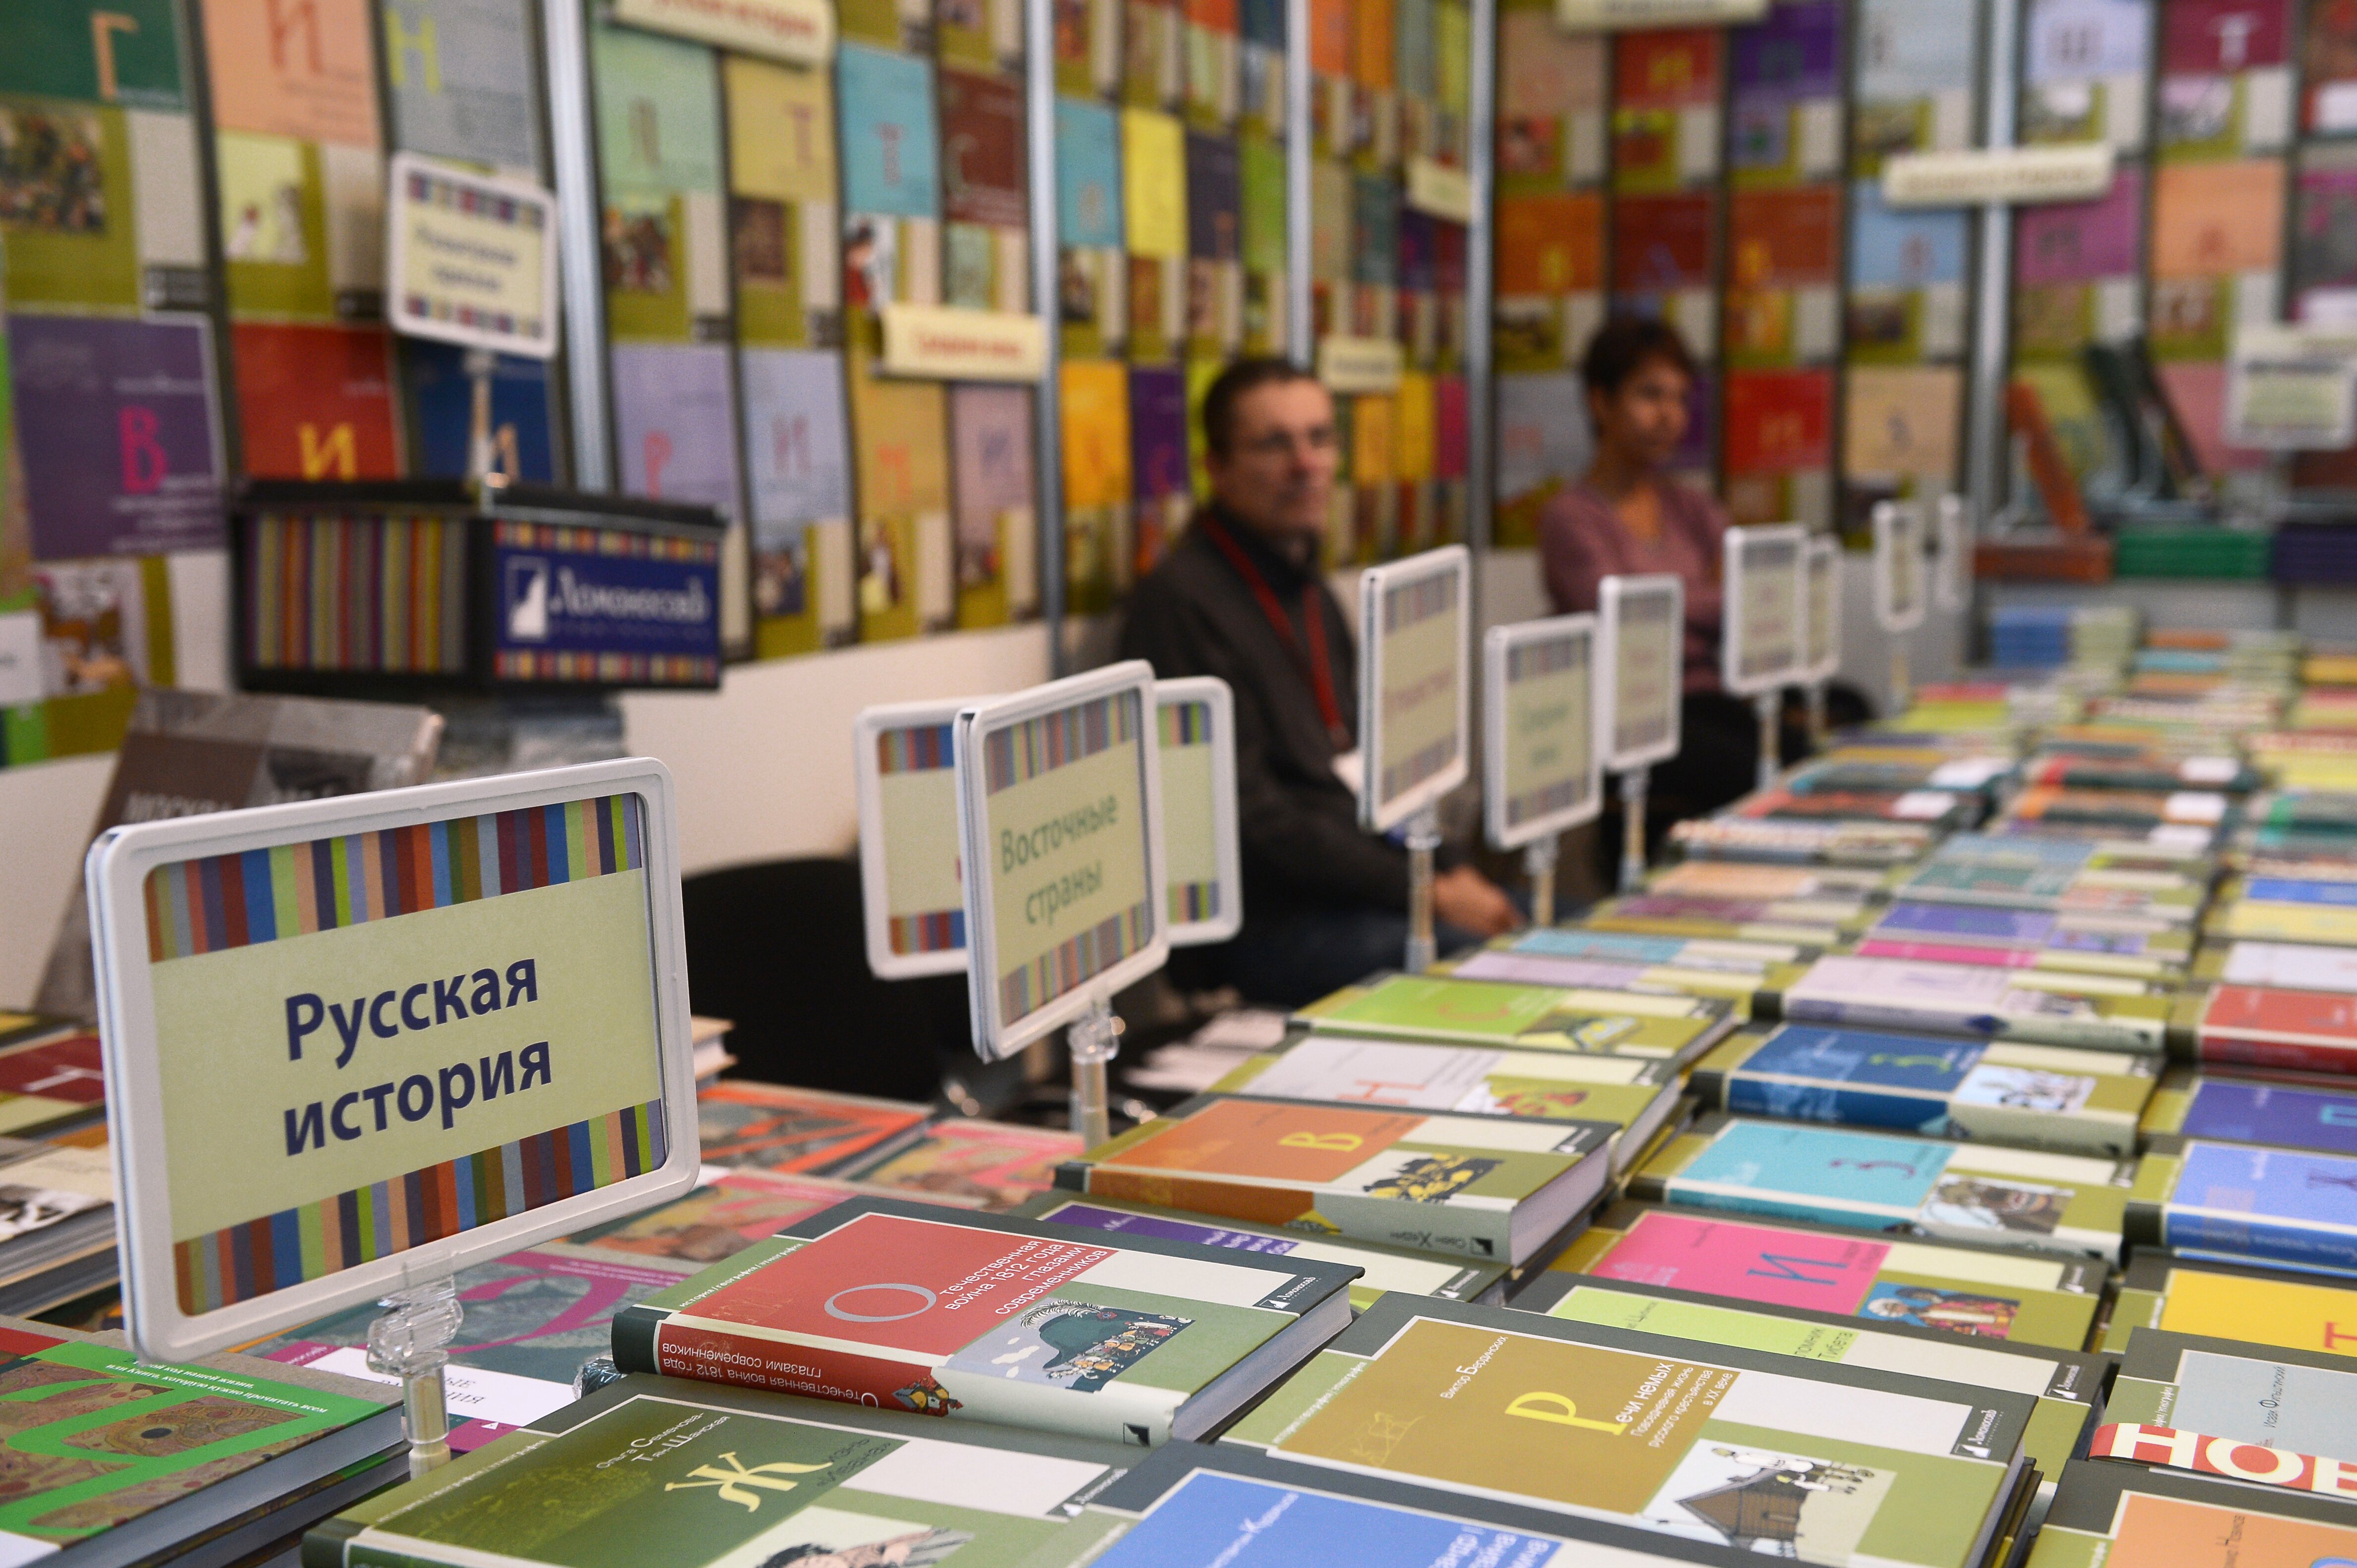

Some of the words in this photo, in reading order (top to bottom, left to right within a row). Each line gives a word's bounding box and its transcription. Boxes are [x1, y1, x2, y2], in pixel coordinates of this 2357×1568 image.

[1000, 793, 1119, 874] Восточные
[1025, 864, 1103, 925] страны
[284, 958, 539, 1068] Русская
[283, 1041, 551, 1156] история
[944, 1283, 995, 1310] война
[993, 1263, 1027, 1286] 1812
[1027, 1243, 1065, 1265] года
[995, 1250, 1108, 1315] современников
[1022, 1247, 1087, 1282] глазами
[662, 1343, 762, 1368] современников
[663, 1358, 692, 1371] года
[697, 1364, 723, 1378] 1812
[766, 1359, 821, 1378] глазами
[1439, 1375, 1471, 1399] Виктор
[1456, 1336, 1508, 1375] Бердинских
[163, 1375, 209, 1389] которую
[208, 1385, 244, 1396] нужно
[242, 1391, 299, 1408] прочитать
[300, 1404, 328, 1413] всем
[183, 1370, 221, 1381] нашей
[728, 1368, 765, 1384] война
[769, 1376, 878, 1408] Отечественная
[1638, 1362, 1674, 1401] немых
[1716, 1373, 1733, 1393] веке
[1630, 1388, 1678, 1438] Повседневная
[1673, 1367, 1694, 1390] жизнь
[1648, 1411, 1680, 1449] русского
[1673, 1369, 1713, 1415] крестьянства
[596, 1448, 638, 1469] Ольга
